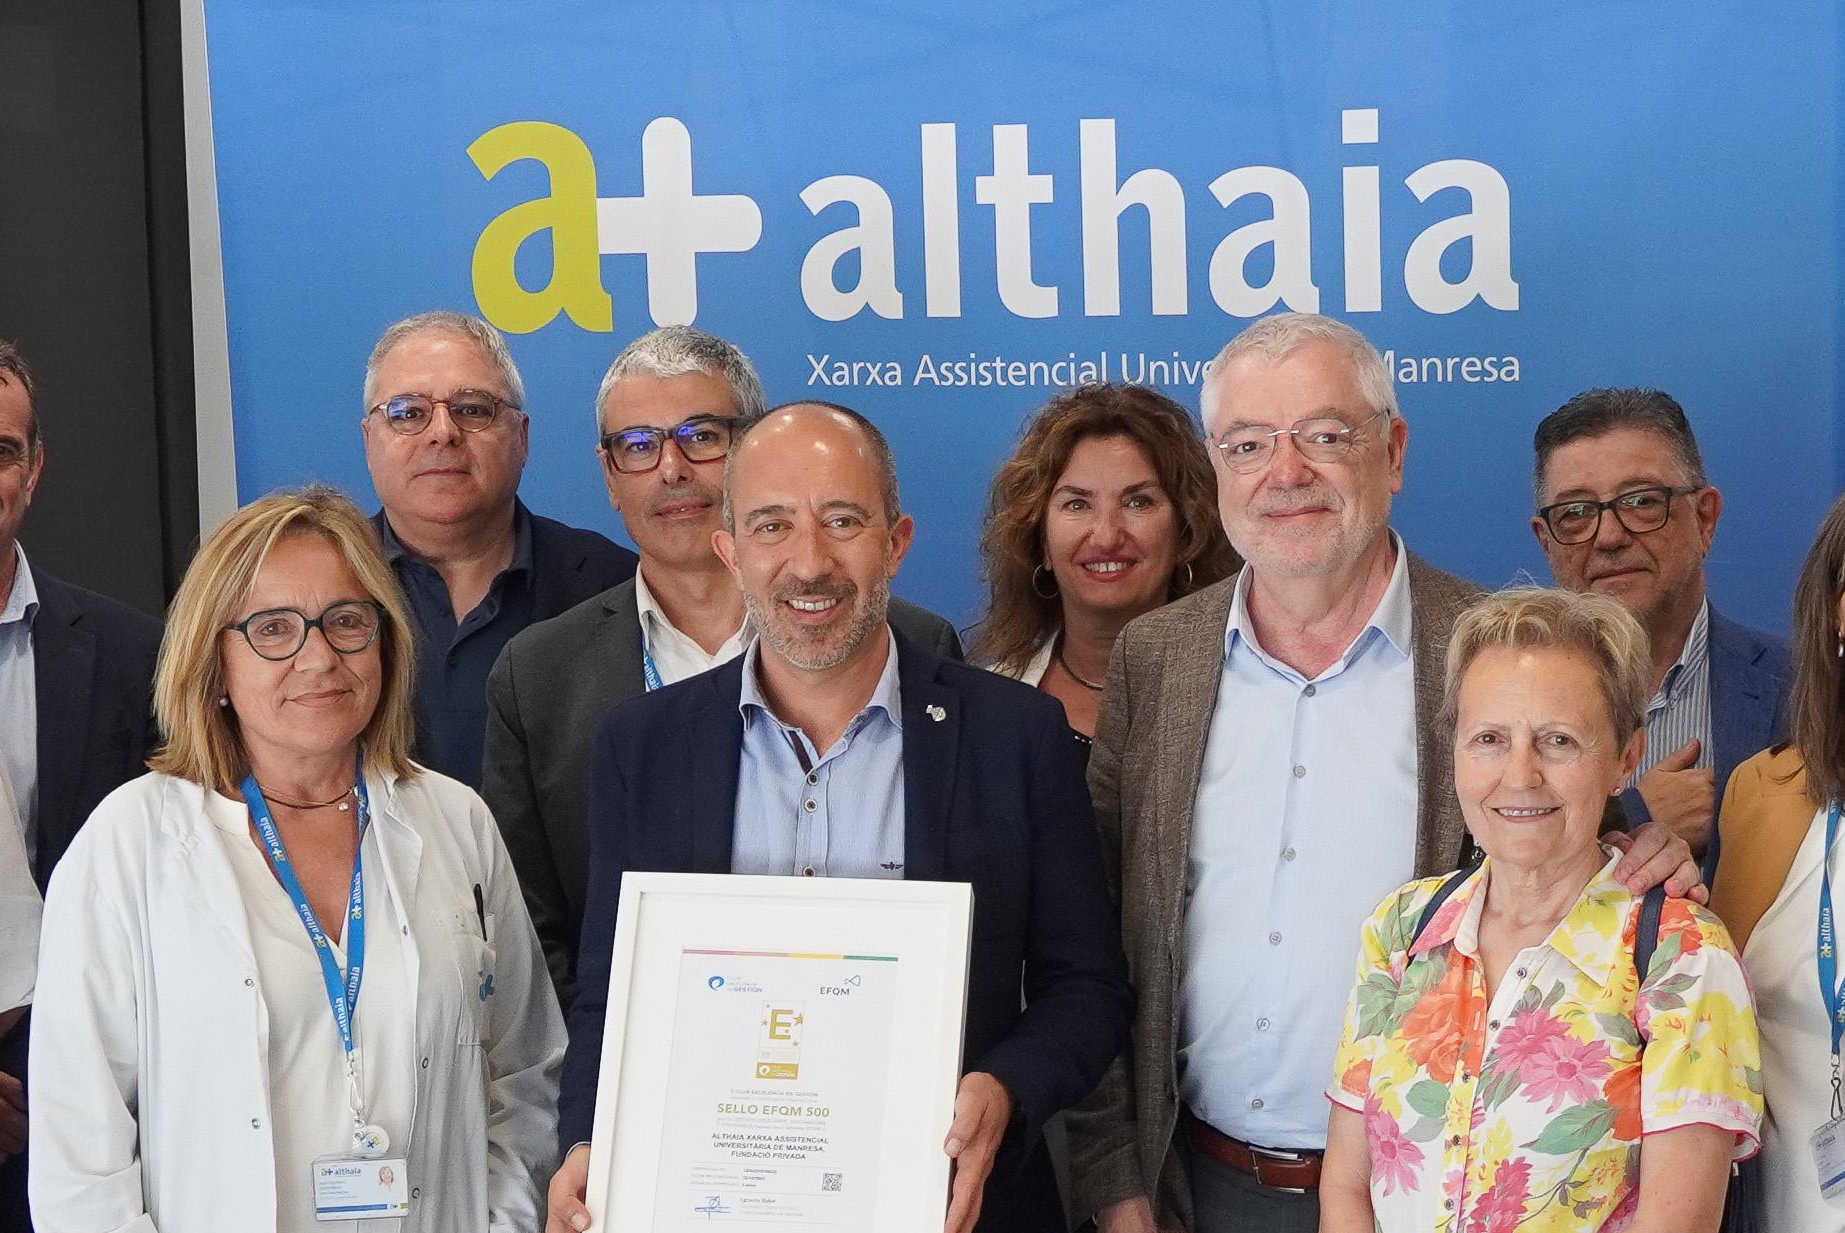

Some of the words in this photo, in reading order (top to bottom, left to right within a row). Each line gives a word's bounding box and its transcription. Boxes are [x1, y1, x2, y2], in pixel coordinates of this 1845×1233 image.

[799, 109, 1520, 322] althaia
[806, 353, 902, 386] Xarxa
[913, 351, 1107, 386] Assistencial
[819, 986, 850, 996] EFQM
[716, 1103, 758, 1115] SELLO
[762, 1105, 802, 1117] EFQM
[806, 1107, 830, 1118] 500
